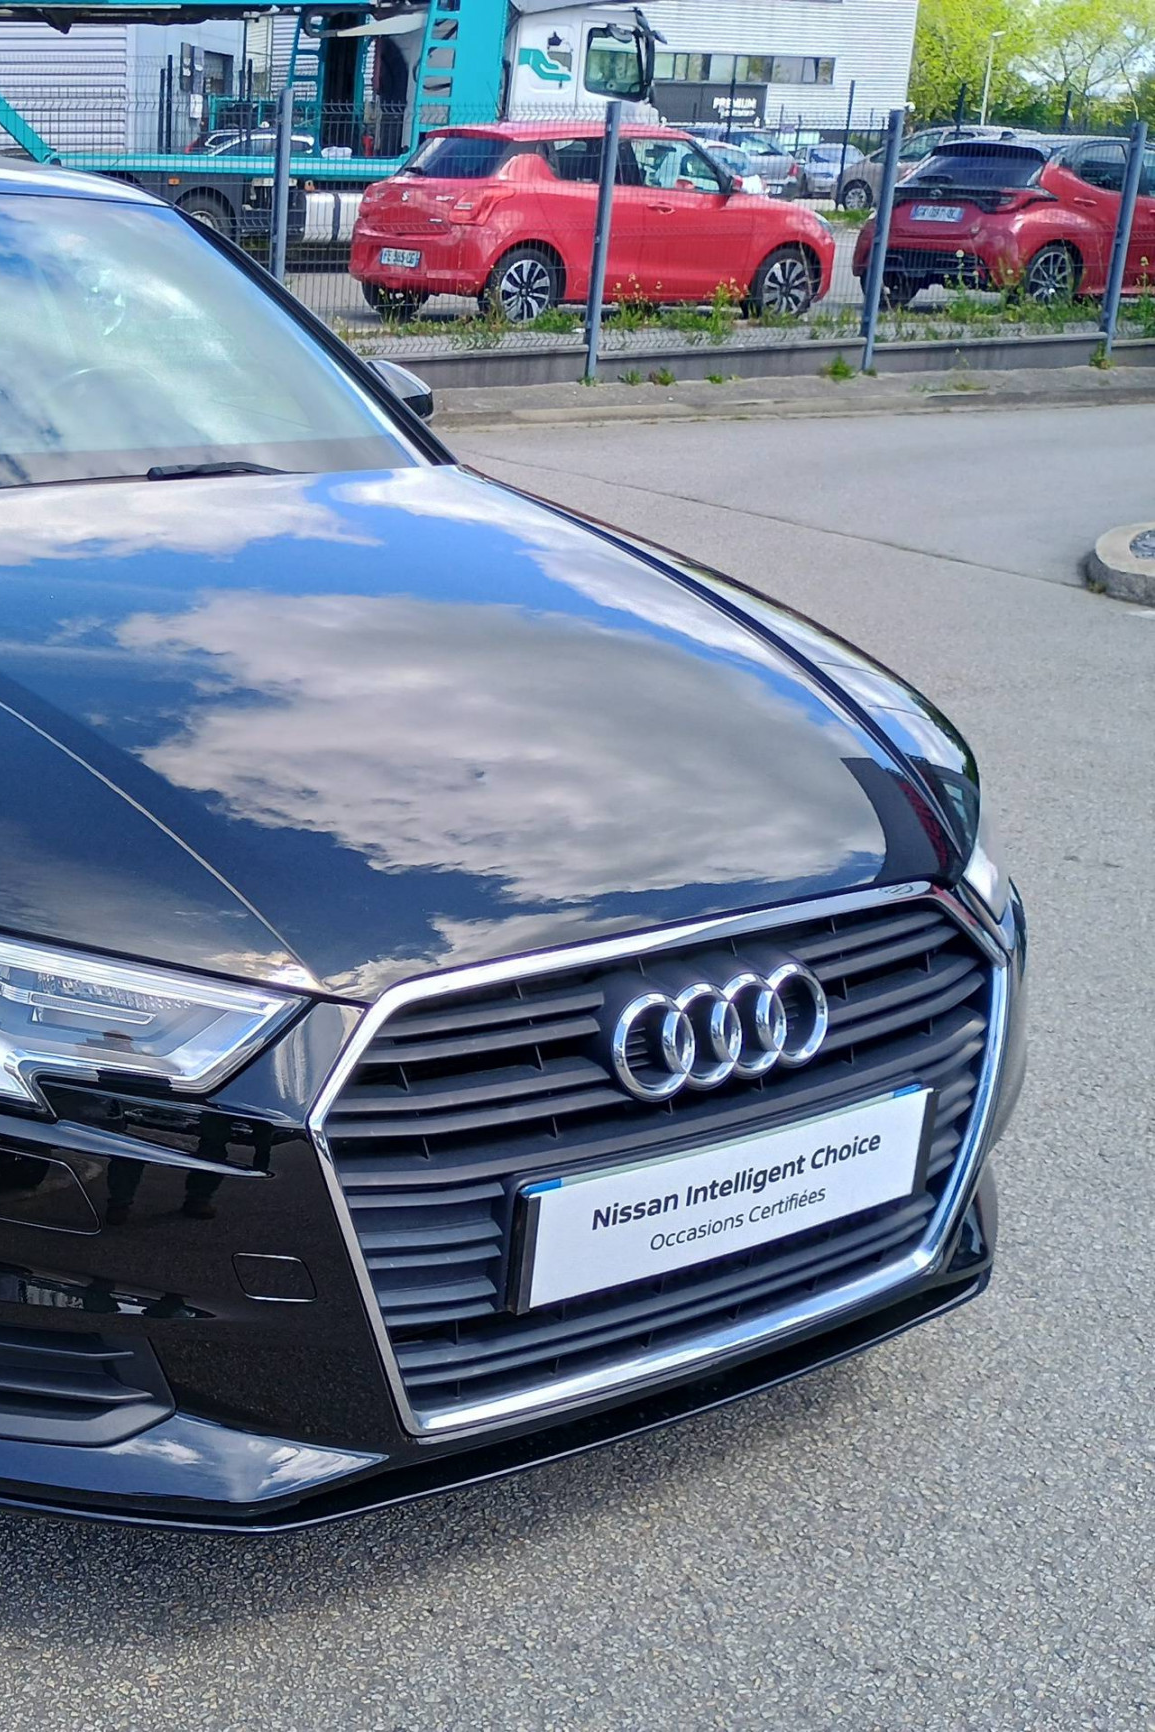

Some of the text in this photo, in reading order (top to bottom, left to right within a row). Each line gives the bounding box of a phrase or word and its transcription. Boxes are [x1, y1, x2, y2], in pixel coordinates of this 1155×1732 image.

[592, 1134, 881, 1230] Nissan Intelligent Choice
[650, 1188, 826, 1250] Occasions Certifiées
